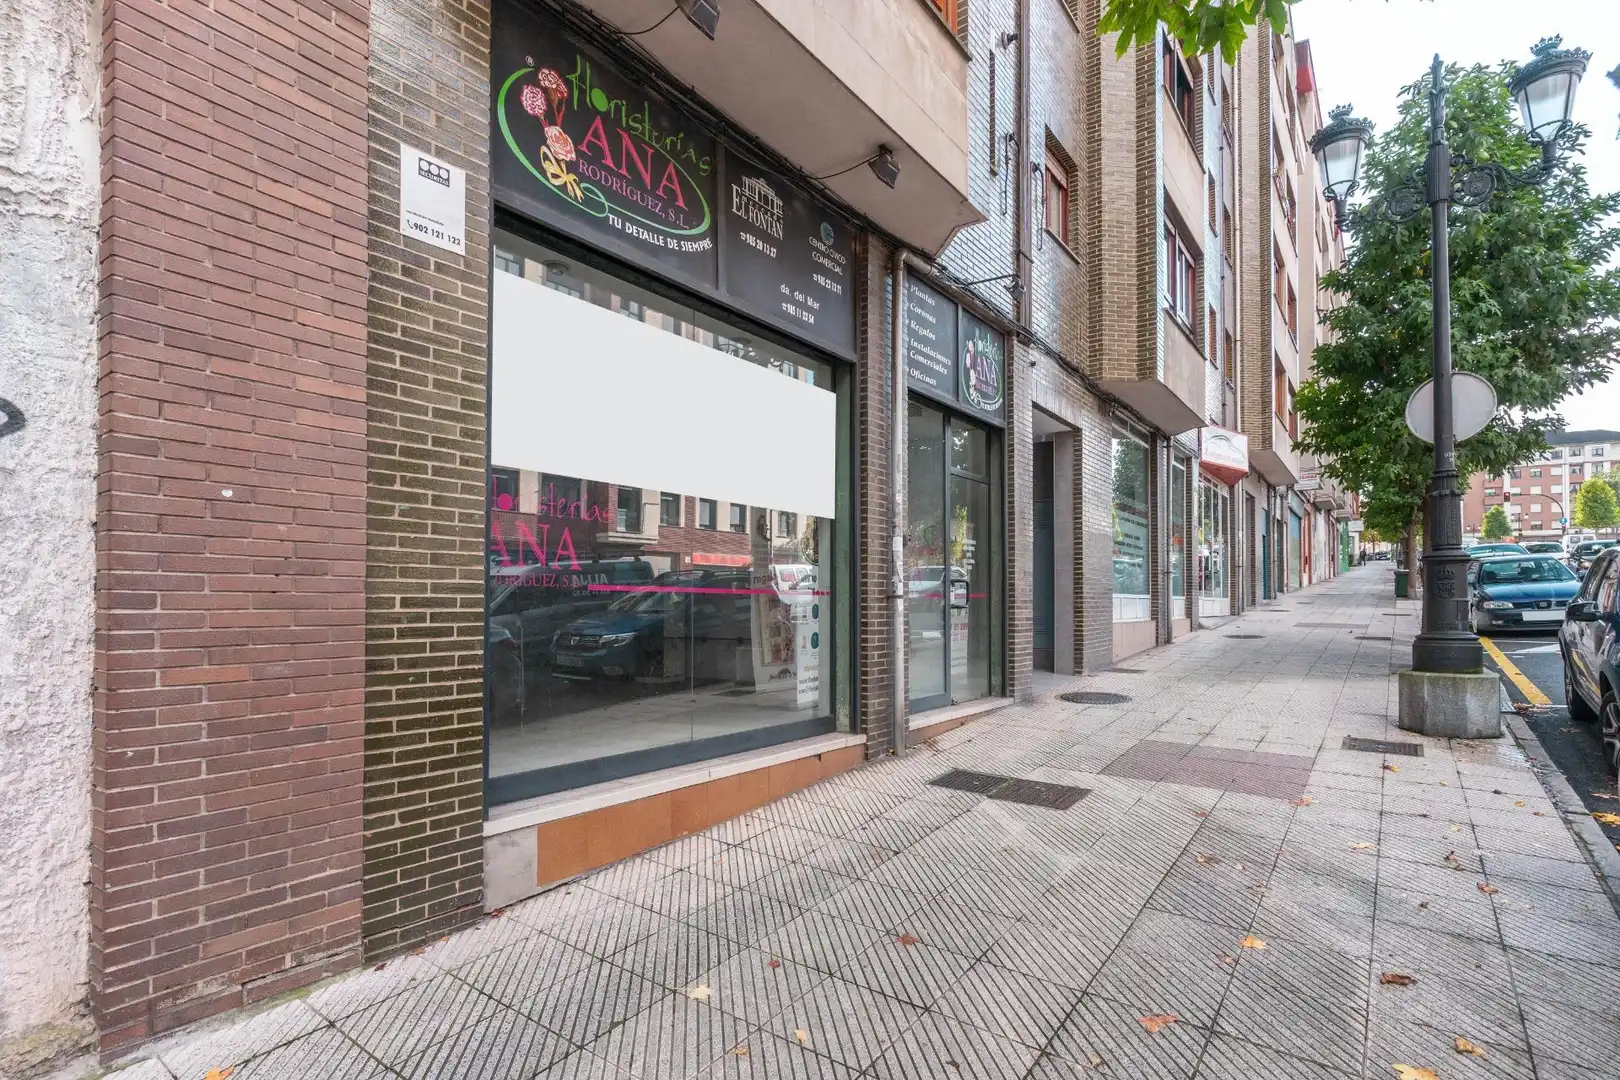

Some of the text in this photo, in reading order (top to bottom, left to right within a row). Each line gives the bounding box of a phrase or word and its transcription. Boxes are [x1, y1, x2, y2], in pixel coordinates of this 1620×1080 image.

[578, 115, 688, 211] ANA
[731, 183, 747, 220] EL
[413, 222, 461, 246] 902 121 122
[608, 213, 713, 252] TU DETALLE DE SIEMPRE
[808, 236, 829, 254] CENTRO
[812, 251, 843, 276] COMERCIAL
[794, 290, 805, 303] del
[807, 296, 820, 310] Mar
[910, 283, 936, 306] Plantas
[910, 302, 937, 324] Coronas
[910, 320, 936, 341] Regalos
[910, 338, 952, 366] Instalaciones
[910, 350, 948, 375] Comerciales
[910, 367, 937, 386] Oficinas
[975, 355, 998, 387] ANA
